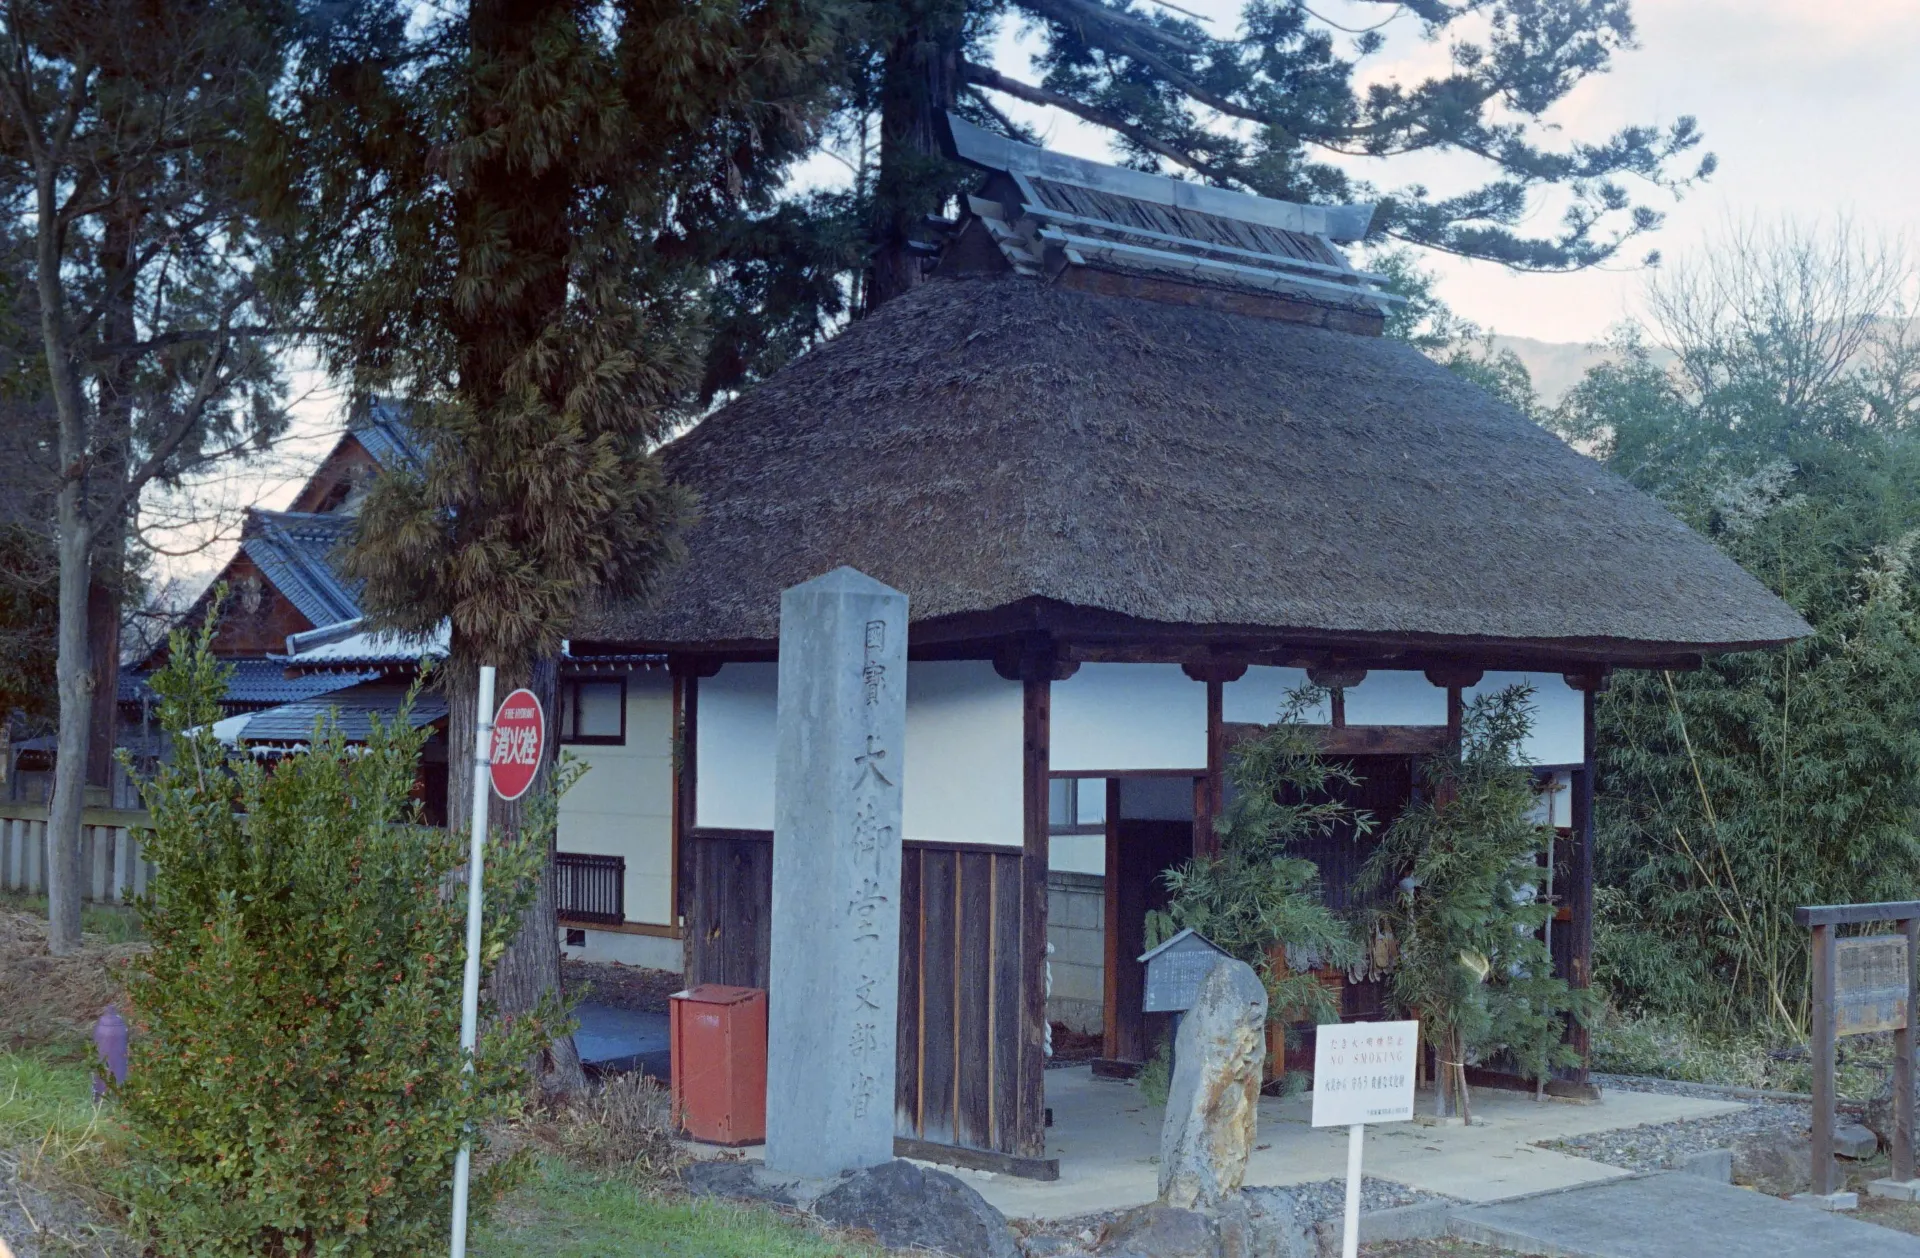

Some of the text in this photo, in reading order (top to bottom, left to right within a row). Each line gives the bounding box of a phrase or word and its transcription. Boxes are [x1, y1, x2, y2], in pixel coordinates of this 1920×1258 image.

[492, 726, 538, 764] 消火栓
[1330, 1051, 1402, 1065] NO SMOKING
